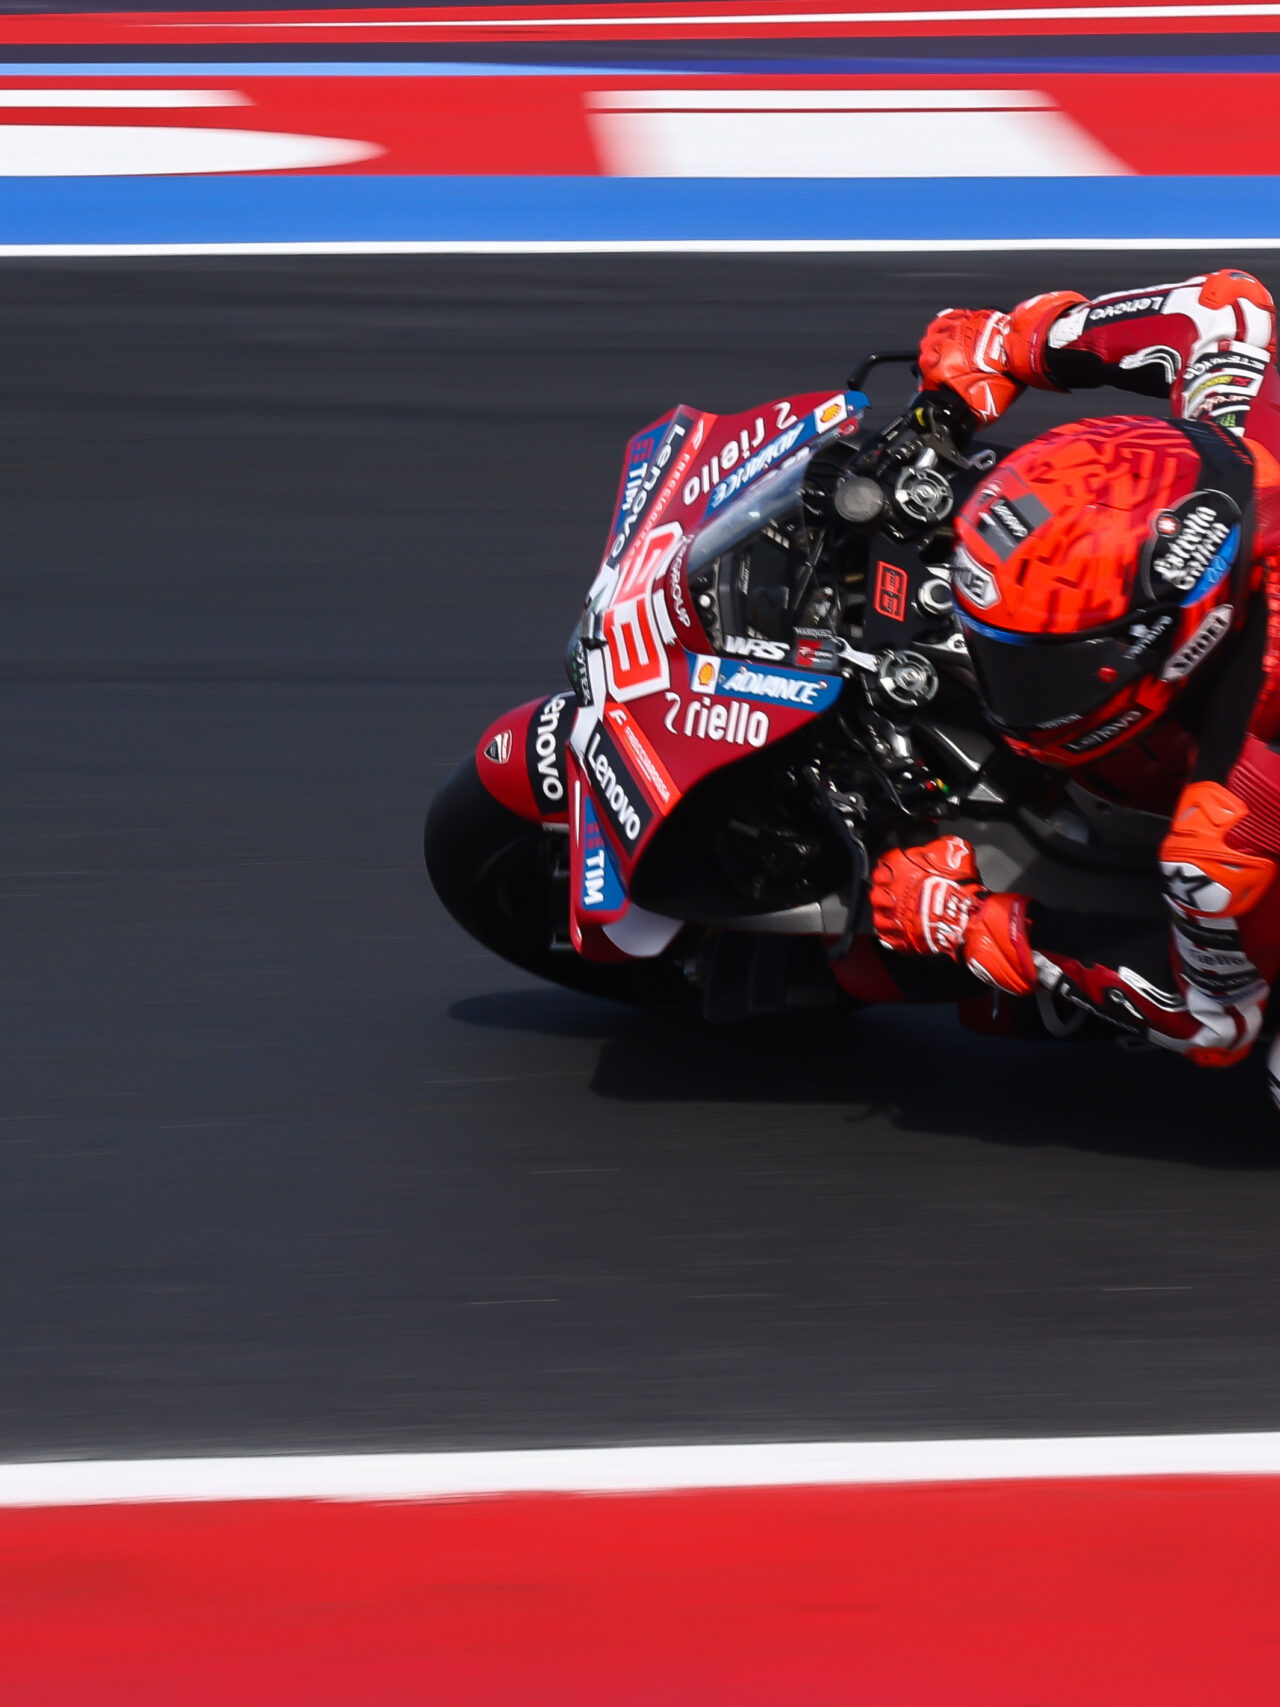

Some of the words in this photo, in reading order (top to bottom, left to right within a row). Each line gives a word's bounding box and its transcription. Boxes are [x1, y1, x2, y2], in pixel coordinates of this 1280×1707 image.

[1089, 297, 1165, 320] Lenovo
[621, 462, 649, 511] TIM
[683, 417, 765, 506] riello
[710, 421, 806, 508] ADVANCE
[611, 423, 687, 559] Lenovo
[724, 634, 791, 661] WRS
[722, 671, 823, 705] ADVANCE
[535, 698, 567, 801] enovo
[684, 695, 770, 748] riello
[587, 732, 641, 841] Lenovo
[584, 850, 606, 906] TIM
